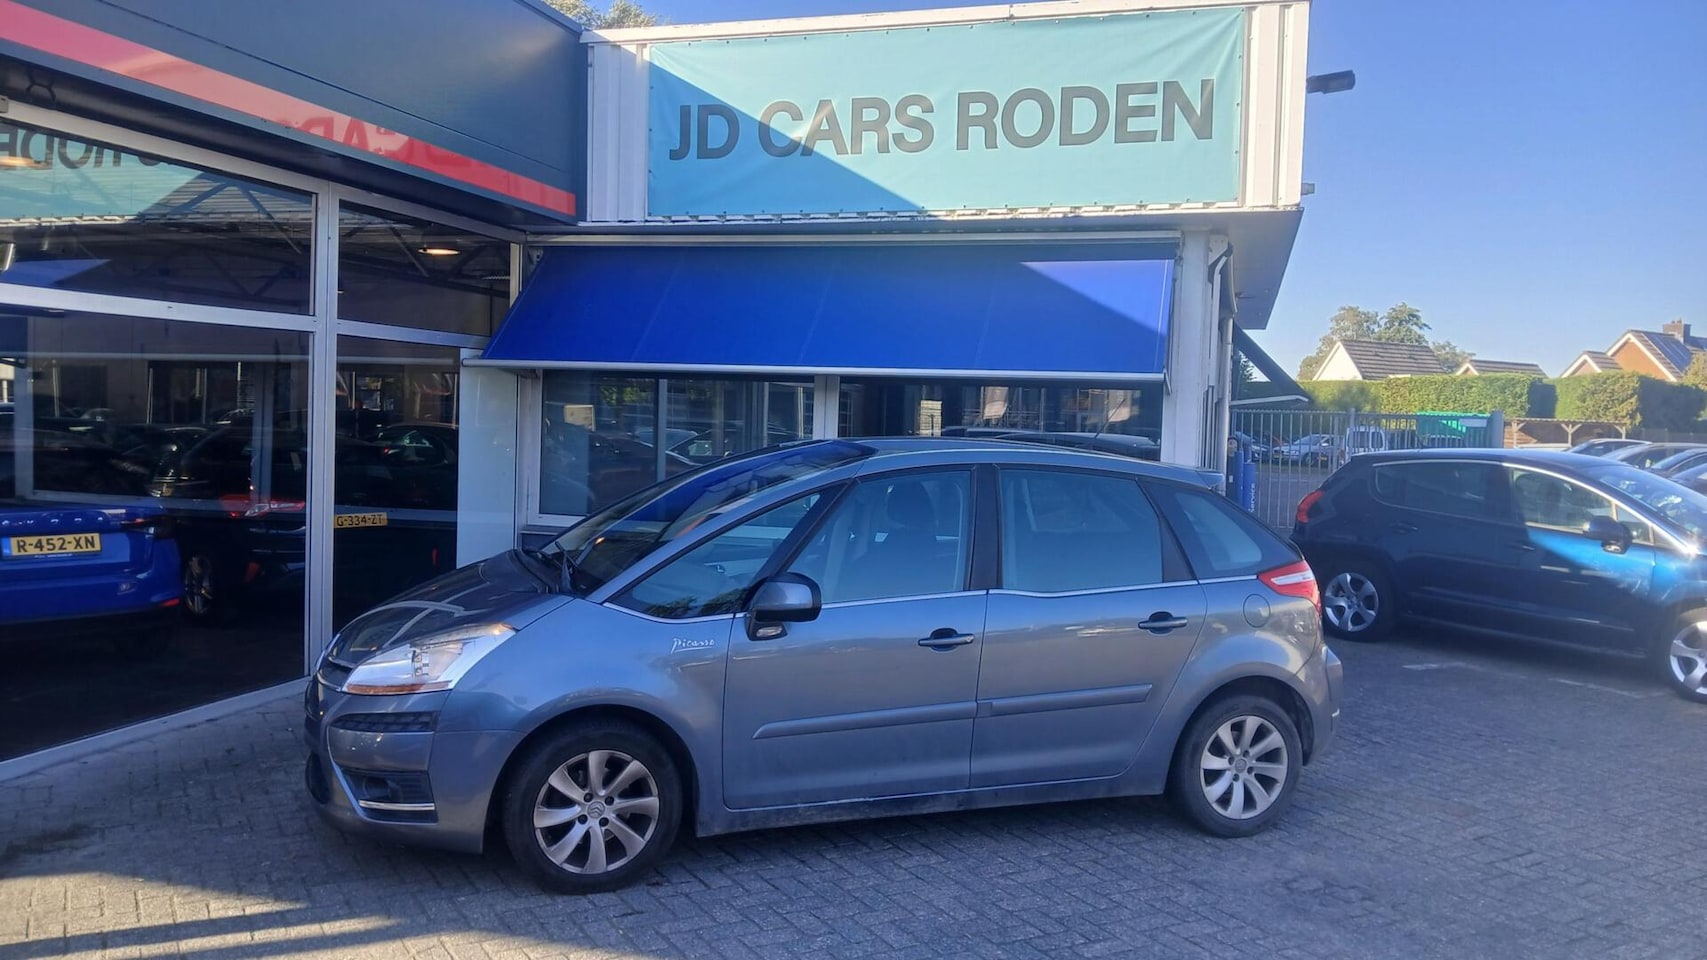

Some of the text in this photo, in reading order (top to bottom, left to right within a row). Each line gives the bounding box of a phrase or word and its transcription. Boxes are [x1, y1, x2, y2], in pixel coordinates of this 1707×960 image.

[669, 78, 1215, 161] JD CARS RODEN
[336, 514, 383, 527] G-334-ZT
[16, 535, 96, 553] R-452-XN
[670, 637, 715, 655] Picasso
